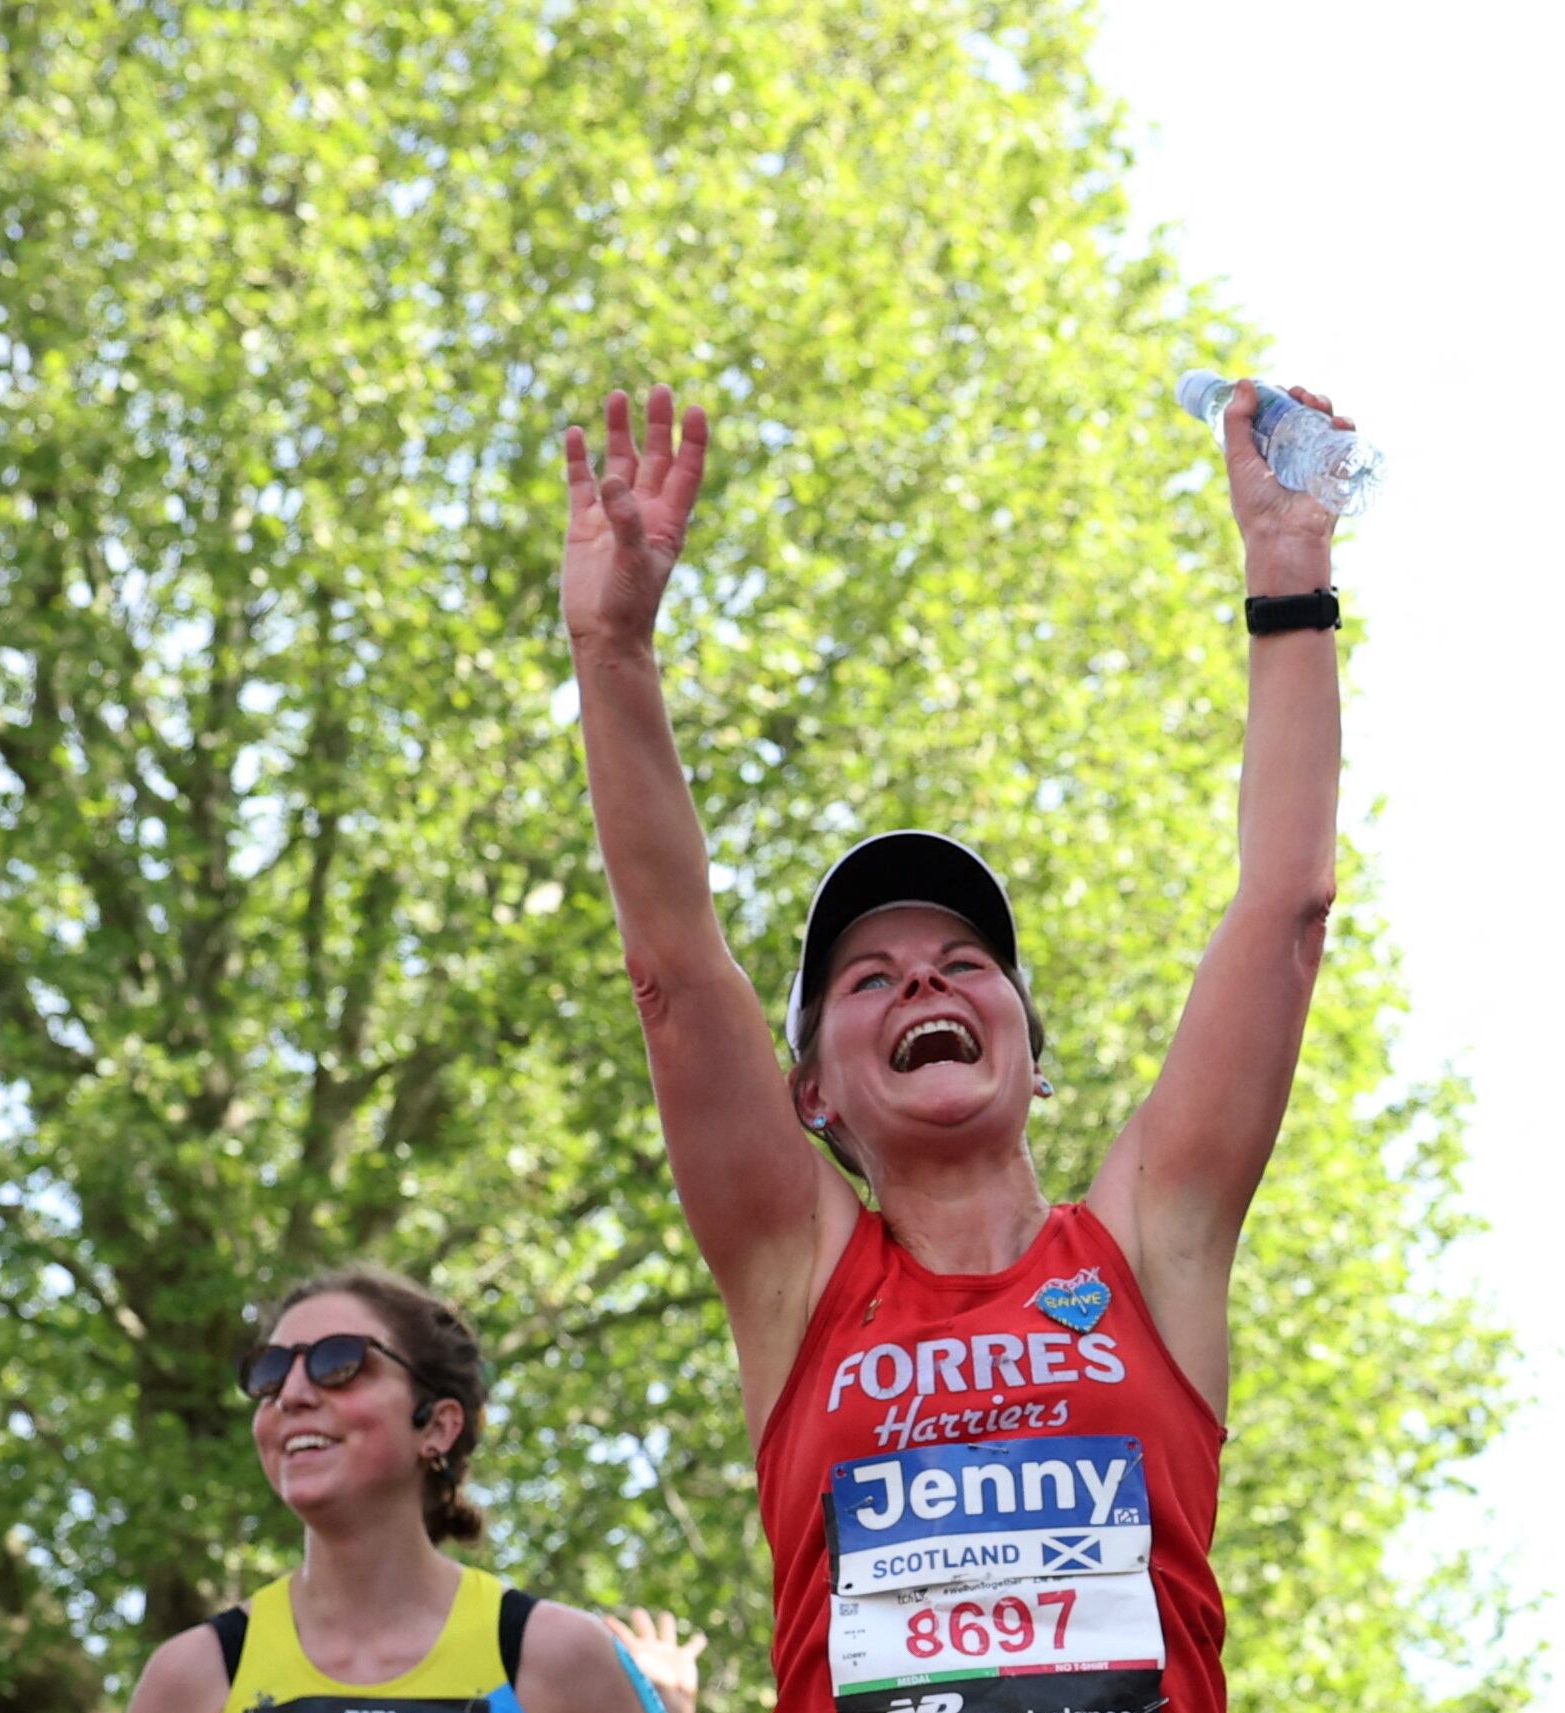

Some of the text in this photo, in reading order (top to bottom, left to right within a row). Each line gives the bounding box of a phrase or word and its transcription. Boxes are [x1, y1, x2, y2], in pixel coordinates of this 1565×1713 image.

[827, 1332, 1127, 1413] FORRES
[873, 1394, 1070, 1451] Harriers
[853, 1458, 1128, 1531] Jenny
[872, 1543, 1020, 1580] SCOTLAND
[906, 1588, 1077, 1658] 8697
[897, 1673, 931, 1687] MEDAL
[1055, 1660, 1110, 1672] NO T-SHIRT
